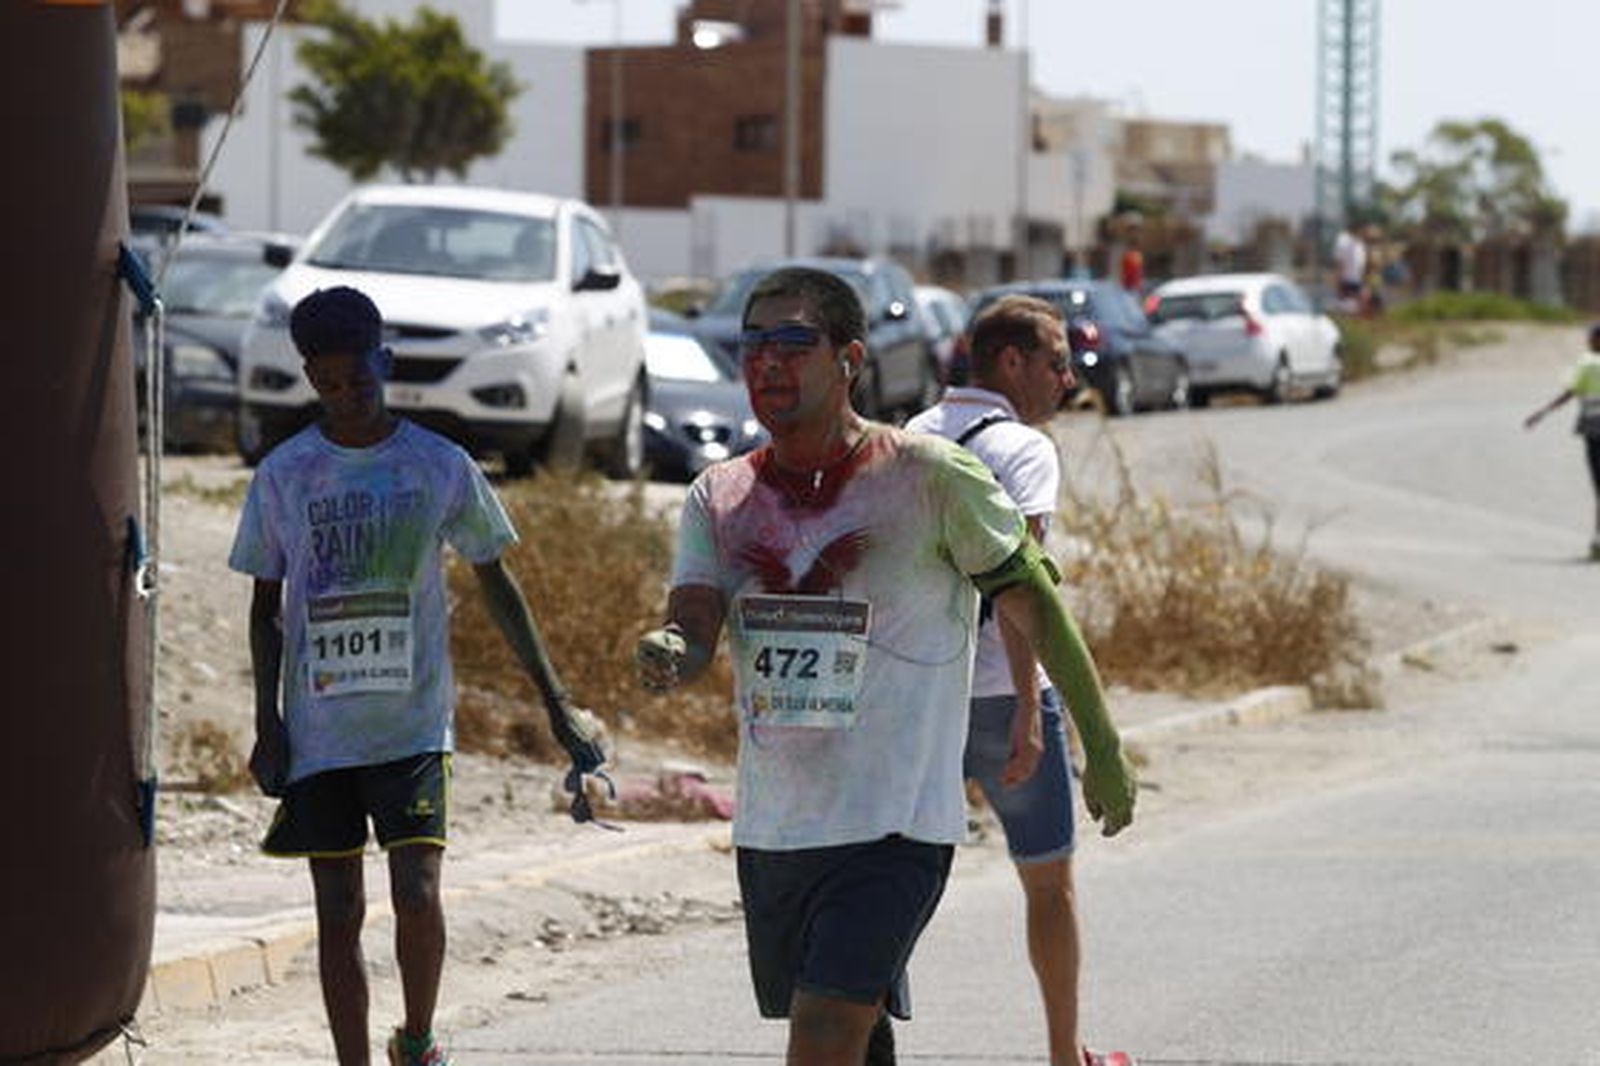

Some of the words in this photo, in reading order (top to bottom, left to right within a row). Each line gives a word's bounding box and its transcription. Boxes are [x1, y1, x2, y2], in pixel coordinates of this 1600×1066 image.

[308, 491, 374, 527] COLOR
[313, 628, 382, 660] 1101
[754, 646, 820, 679] 472
